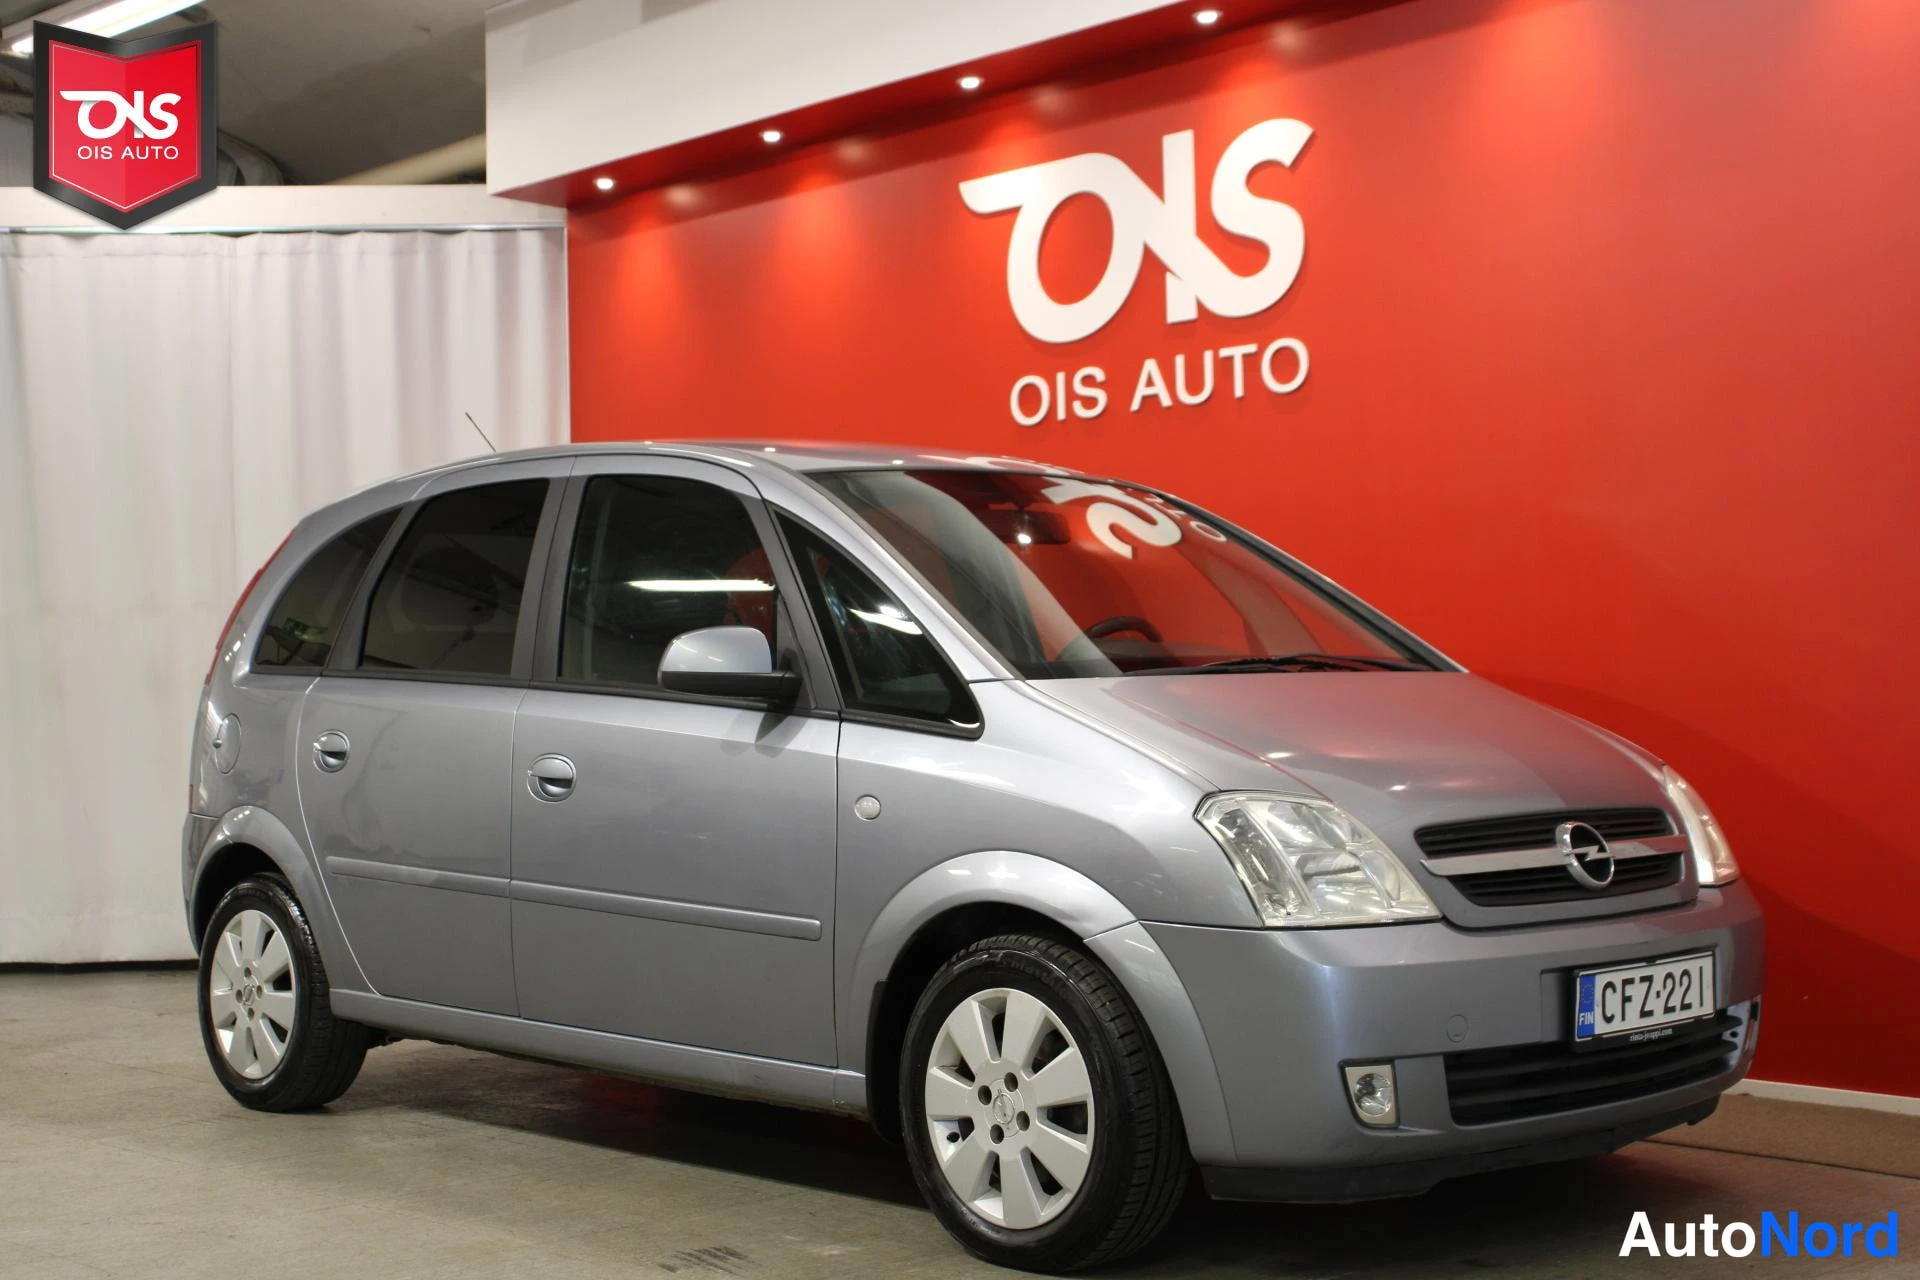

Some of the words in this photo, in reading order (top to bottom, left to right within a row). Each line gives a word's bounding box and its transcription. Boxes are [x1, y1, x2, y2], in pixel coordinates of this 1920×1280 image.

[958, 117, 1315, 344] OIS
[1010, 366, 1108, 427] OIS
[1130, 337, 1311, 412] AUTO
[1579, 1011, 1594, 1026] FIN
[1601, 965, 1704, 1024] CFZ-221
